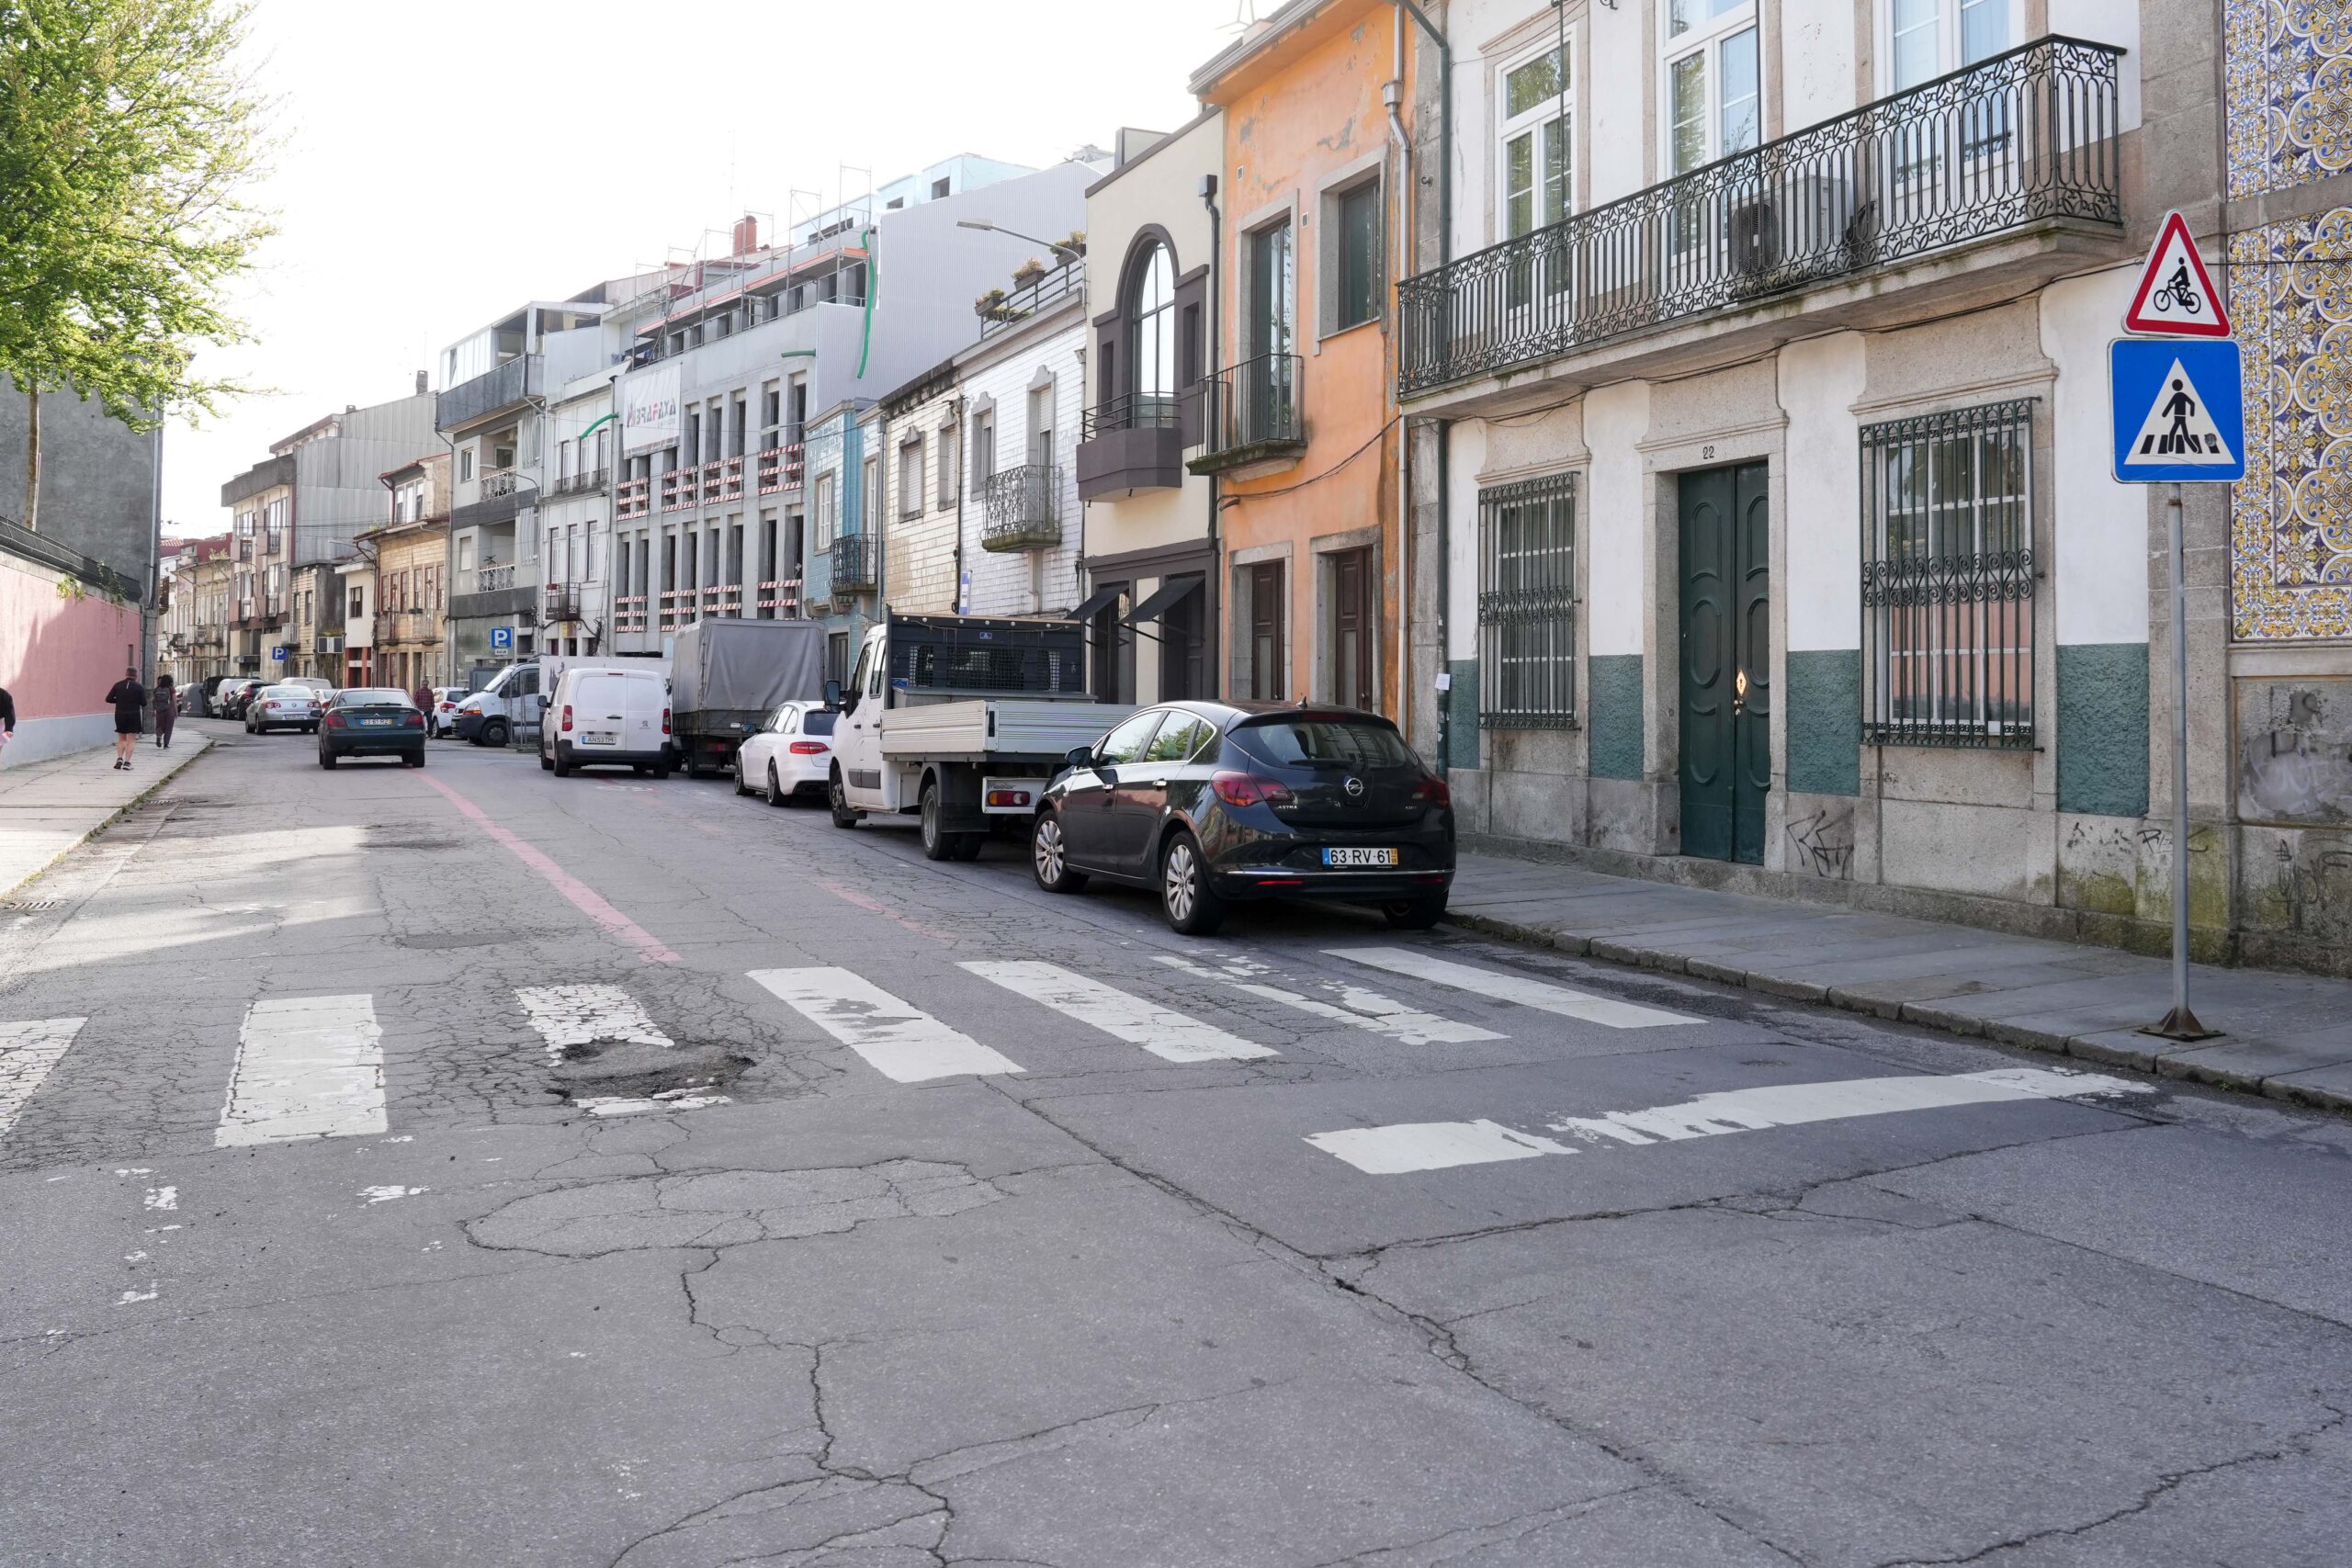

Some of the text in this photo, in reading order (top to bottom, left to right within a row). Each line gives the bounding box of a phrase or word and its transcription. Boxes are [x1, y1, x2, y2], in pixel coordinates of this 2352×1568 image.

[1702, 445, 1714, 459] 22
[494, 629, 508, 647] P
[276, 648, 285, 660] P
